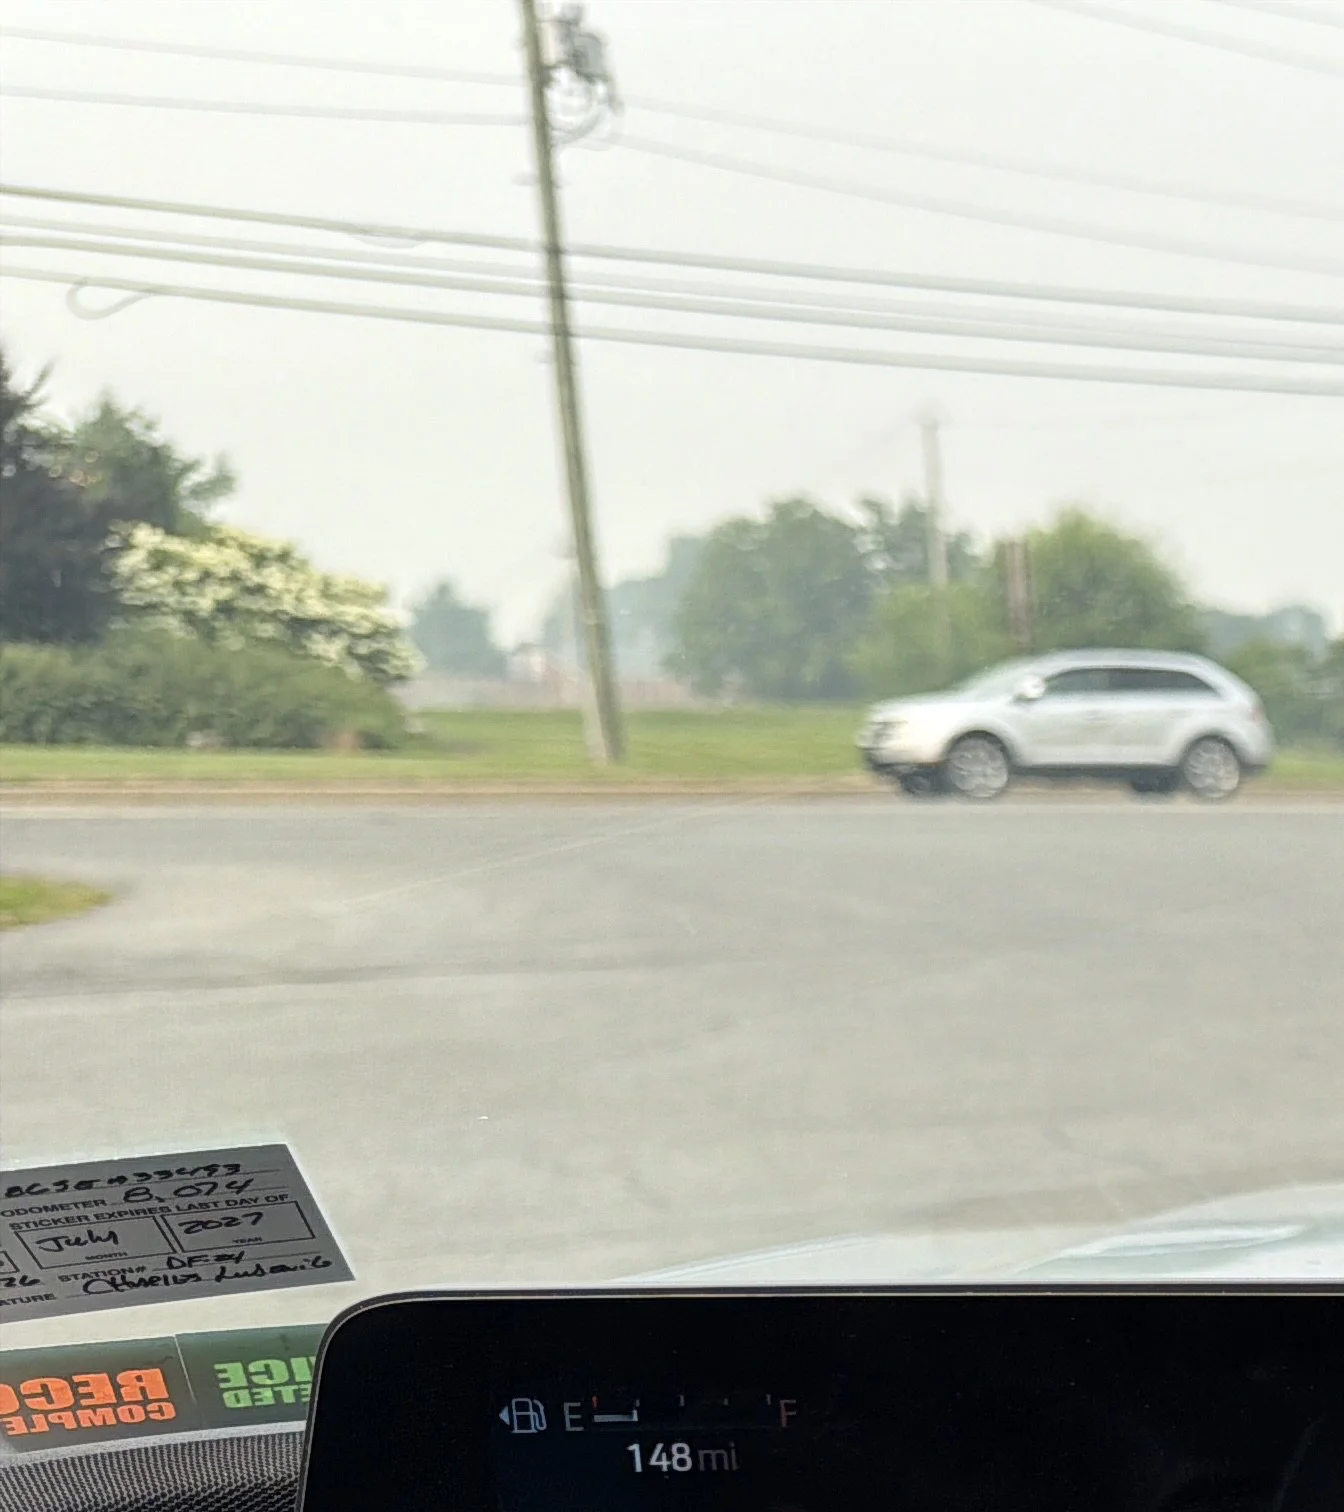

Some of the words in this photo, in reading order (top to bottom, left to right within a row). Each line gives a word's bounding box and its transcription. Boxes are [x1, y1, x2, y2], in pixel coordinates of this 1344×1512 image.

[1, 1199, 108, 1217] ODOMETER
[9, 1213, 91, 1231] STICKER
[93, 1204, 172, 1221] EXPIRES
[175, 1199, 220, 1212] LAST
[224, 1195, 260, 1208] DAY
[264, 1193, 290, 1204] OF
[35, 1229, 119, 1253] July
[178, 1211, 264, 1235] 2027
[84, 1251, 128, 1261] MONTH
[232, 1236, 263, 1244] YEAR
[58, 1265, 147, 1283] STATION#
[563, 1402, 585, 1432] E
[779, 1399, 797, 1428] F
[627, 1442, 693, 1473] 148
[697, 1441, 739, 1472] mi
